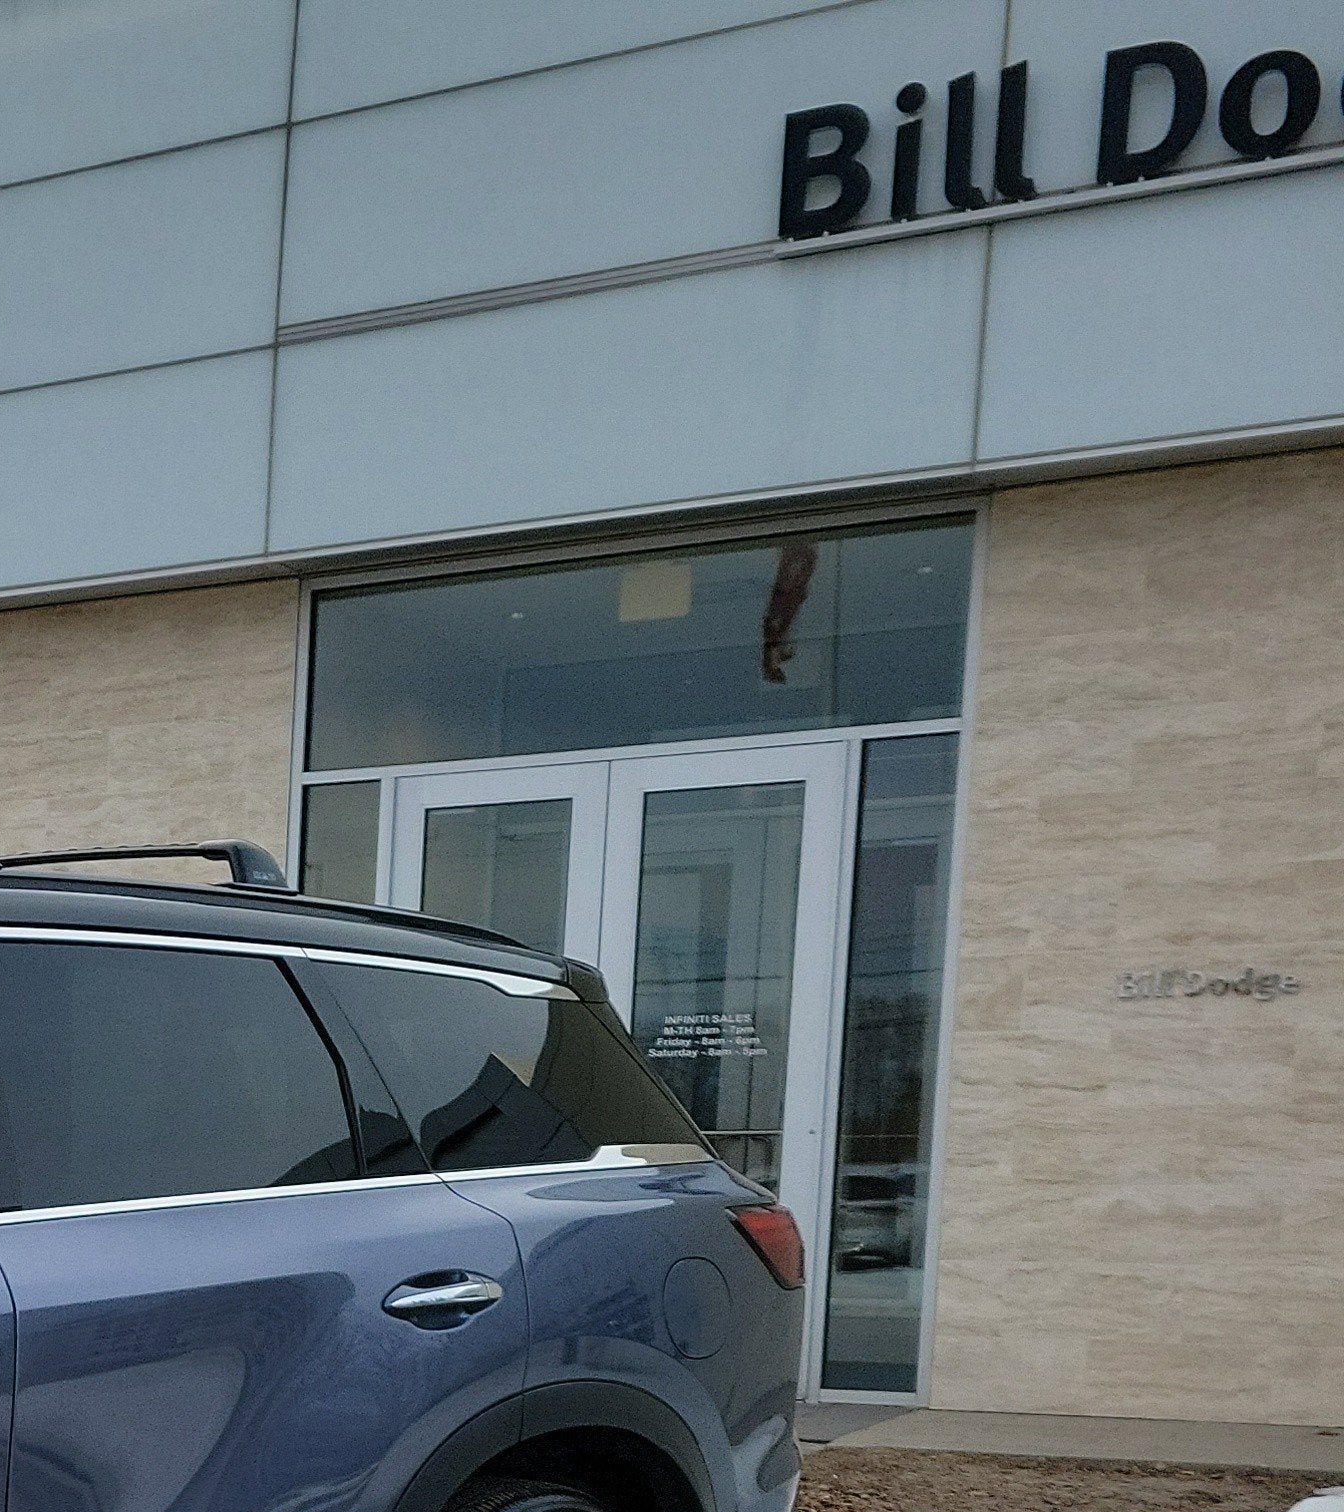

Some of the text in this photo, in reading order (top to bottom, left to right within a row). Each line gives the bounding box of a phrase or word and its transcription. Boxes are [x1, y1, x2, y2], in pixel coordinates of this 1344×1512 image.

[778, 40, 1344, 242] Bill Do
[1178, 967, 1299, 1001] Dodge
[664, 1013, 753, 1025] INFINITI SALES
[663, 1026, 695, 1035] M-TH
[657, 1037, 692, 1047] Friday
[648, 1048, 700, 1058] Saturday
